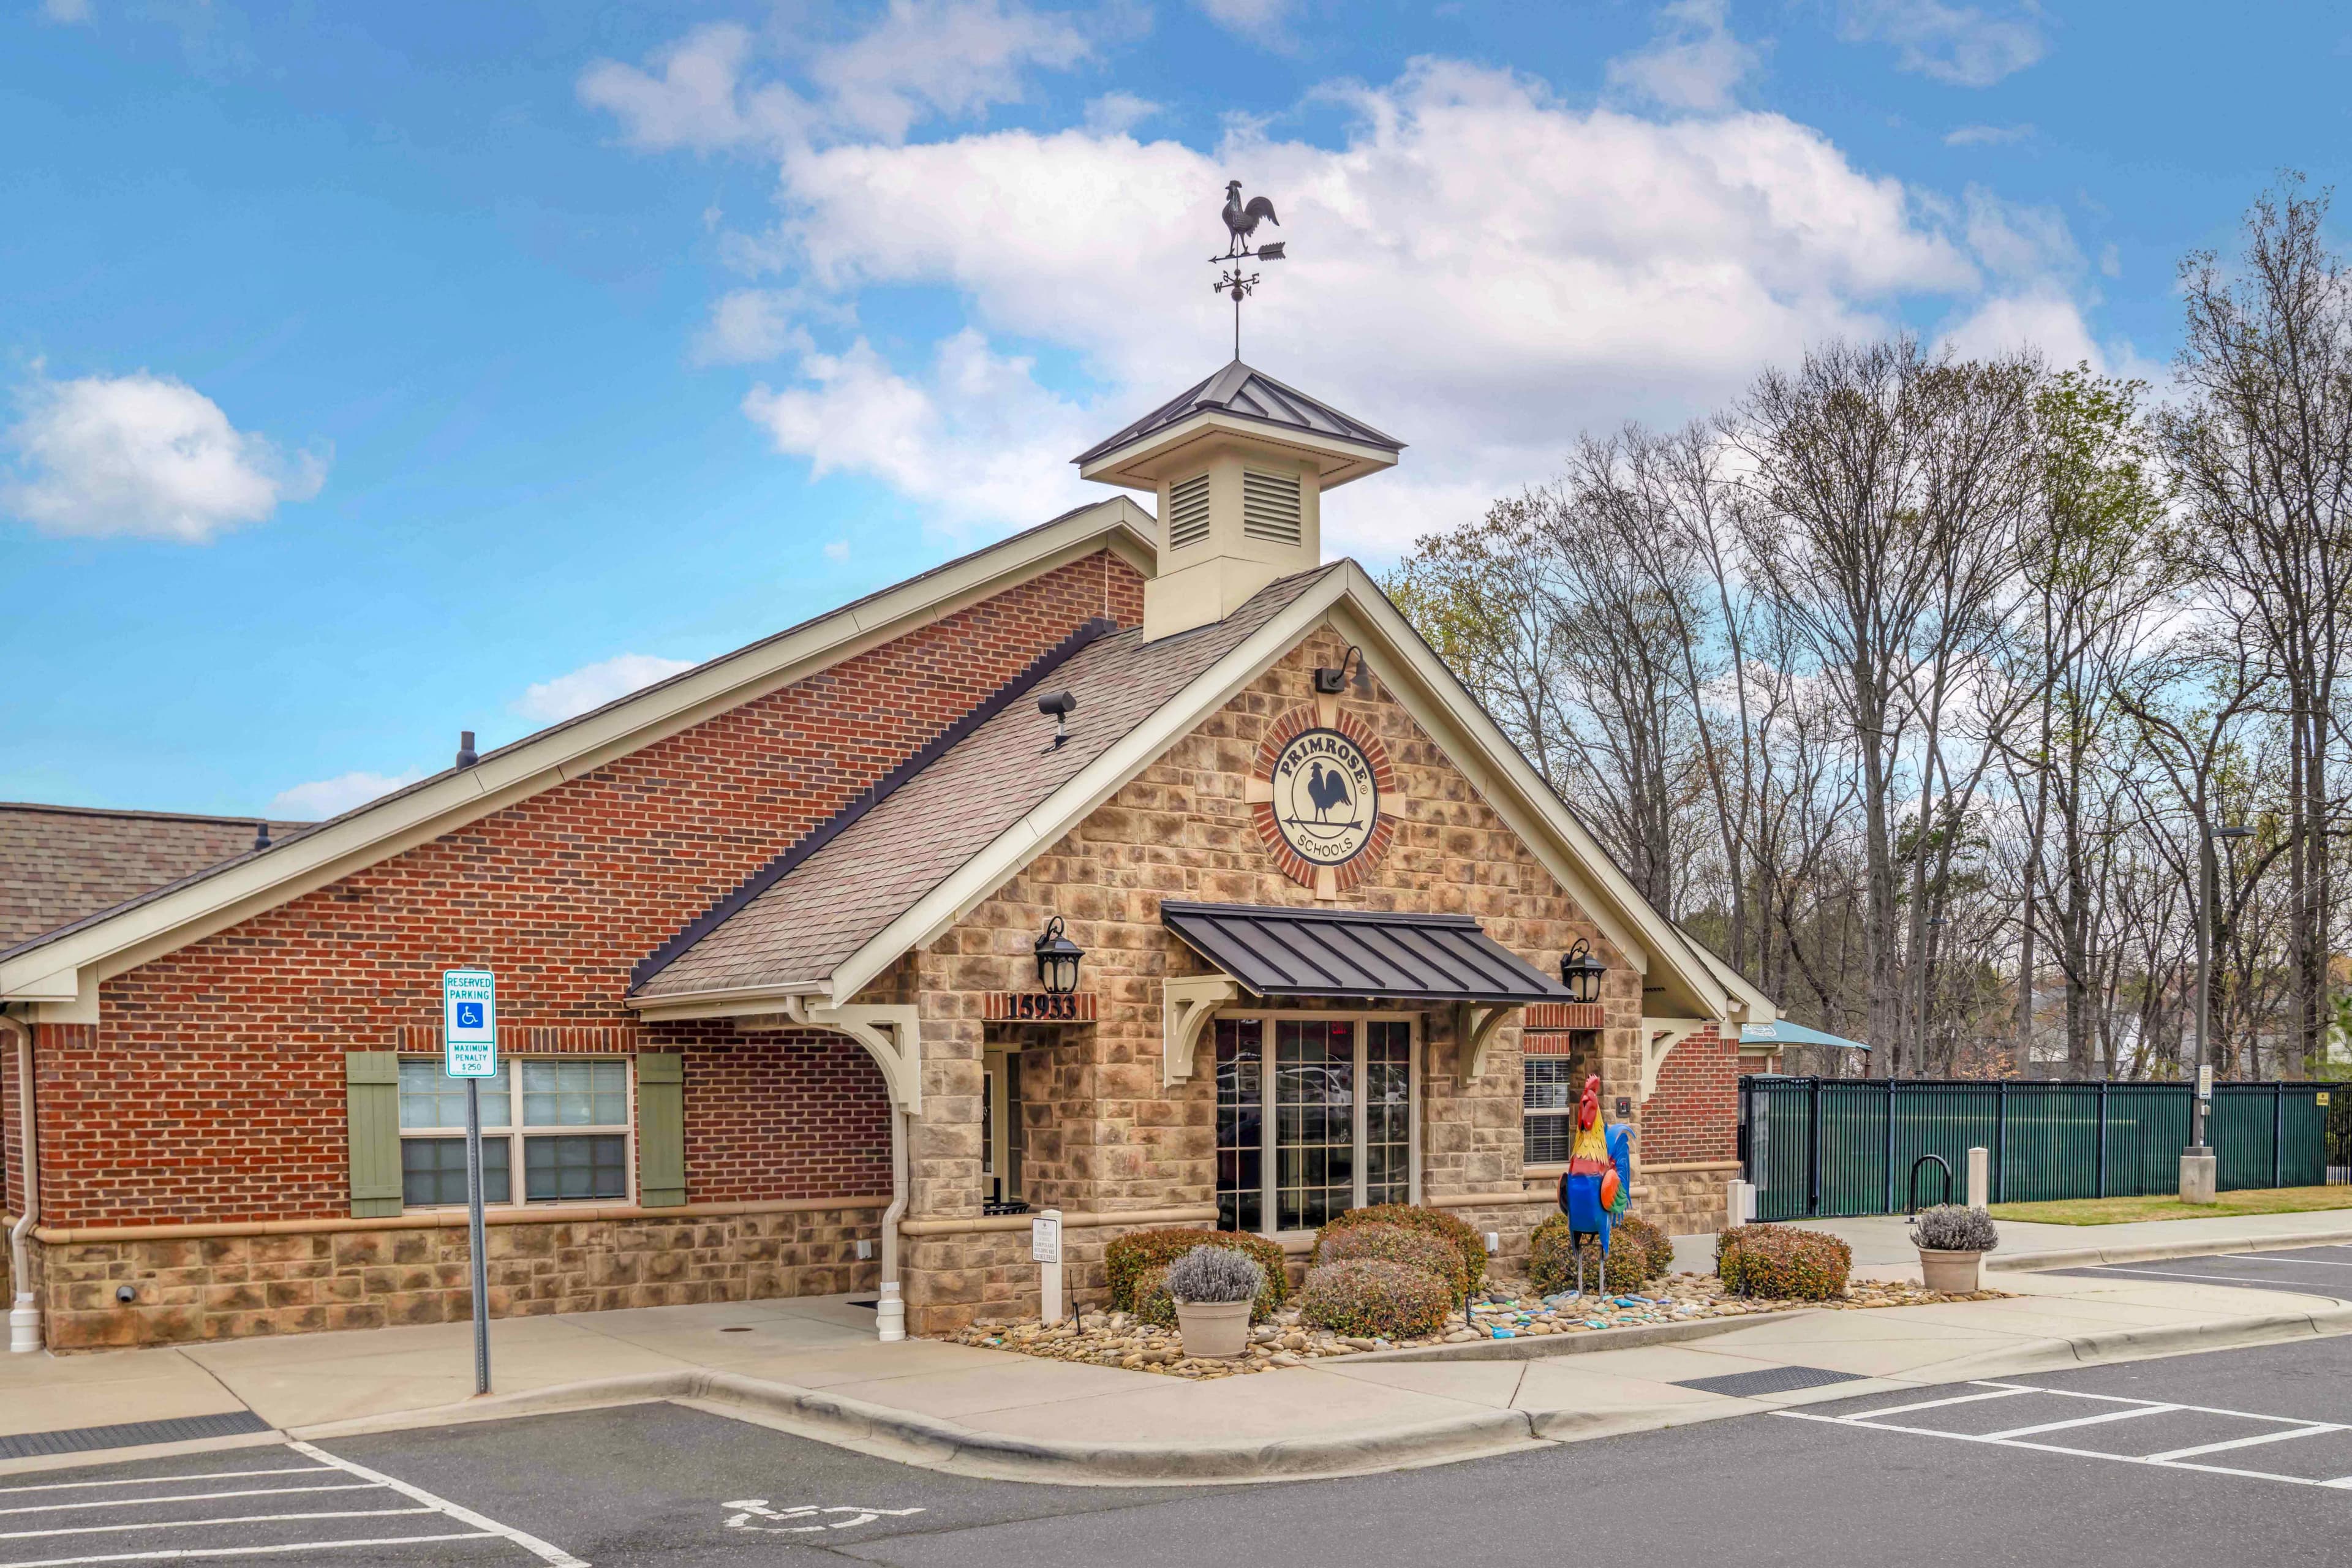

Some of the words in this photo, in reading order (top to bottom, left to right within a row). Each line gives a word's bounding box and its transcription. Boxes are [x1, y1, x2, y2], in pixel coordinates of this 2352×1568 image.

[1252, 273, 1260, 285] E
[1213, 282, 1223, 293] W
[1280, 737, 1367, 784] PRIMROSE
[1297, 834, 1353, 857] SCHOOLS
[448, 978, 491, 987] RESERVED
[450, 990, 489, 1000] PARKING
[1008, 995, 1077, 1019] 15933
